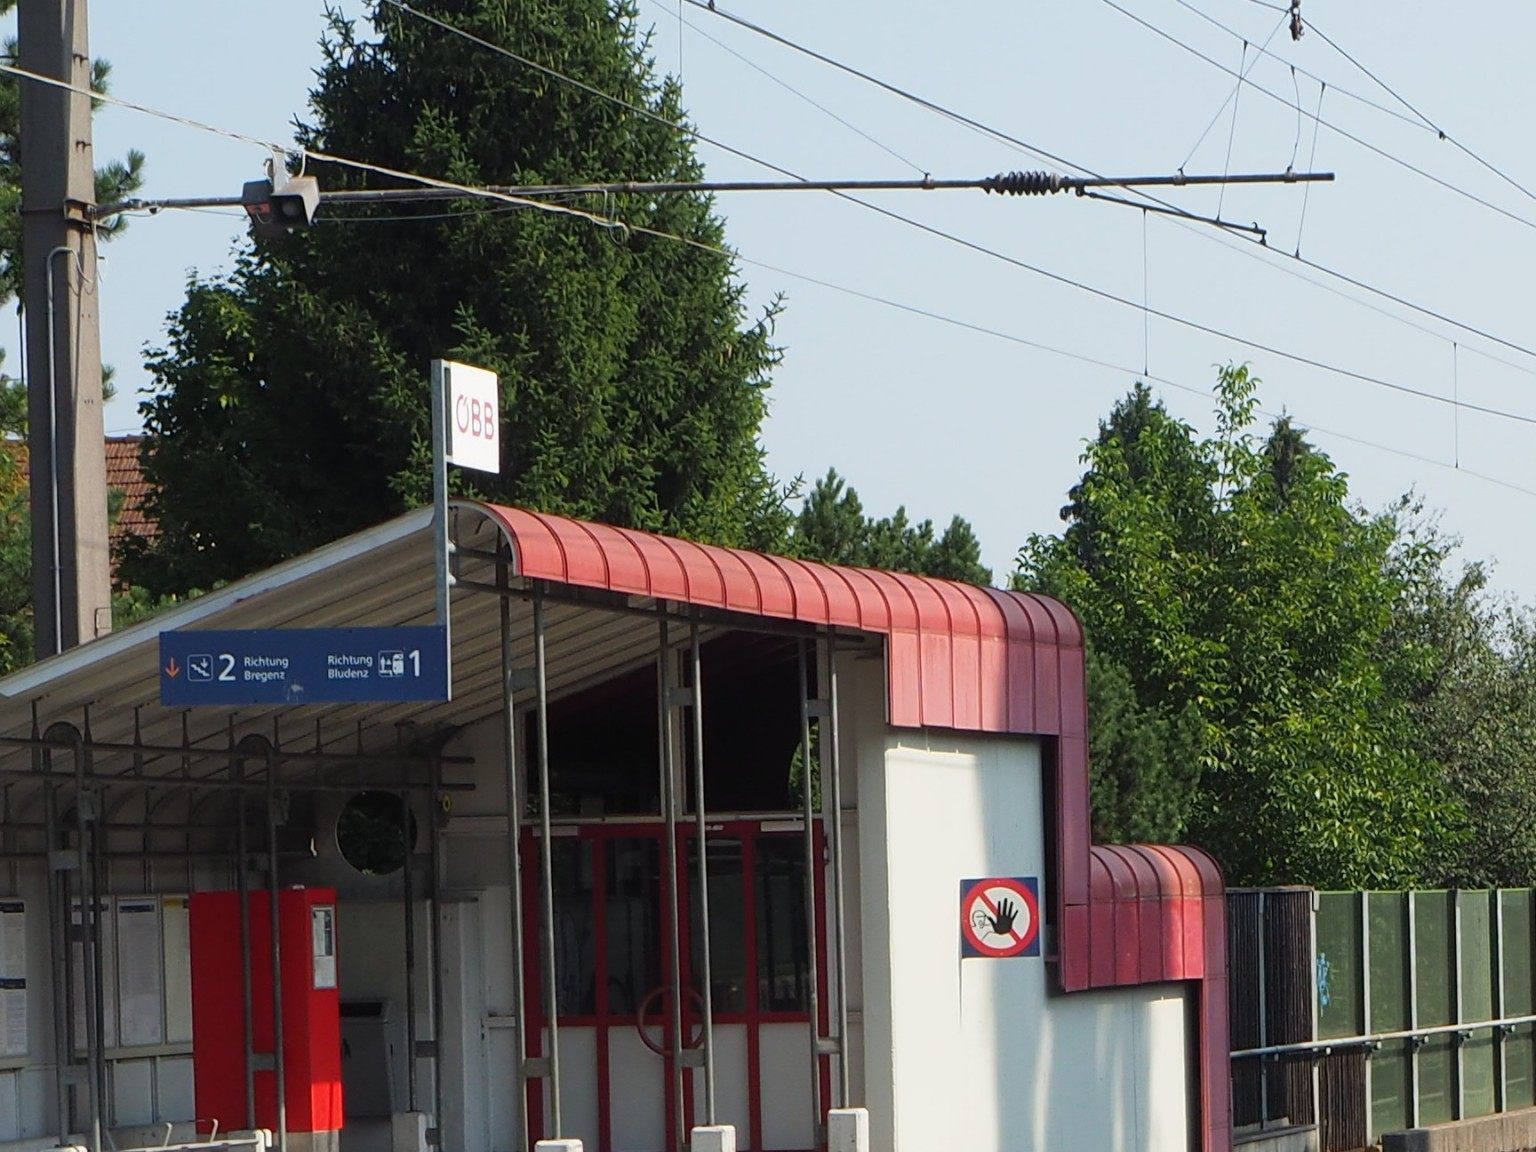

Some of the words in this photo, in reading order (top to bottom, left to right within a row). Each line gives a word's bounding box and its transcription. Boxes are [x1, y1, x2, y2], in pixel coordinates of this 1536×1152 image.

[456, 394, 494, 440] ÖBB
[218, 653, 236, 681] 2
[244, 656, 289, 669] Richtung
[327, 654, 373, 667] Richtung
[408, 649, 421, 677] 1
[244, 669, 286, 682] Bregenz
[328, 668, 369, 679] Bludenz
